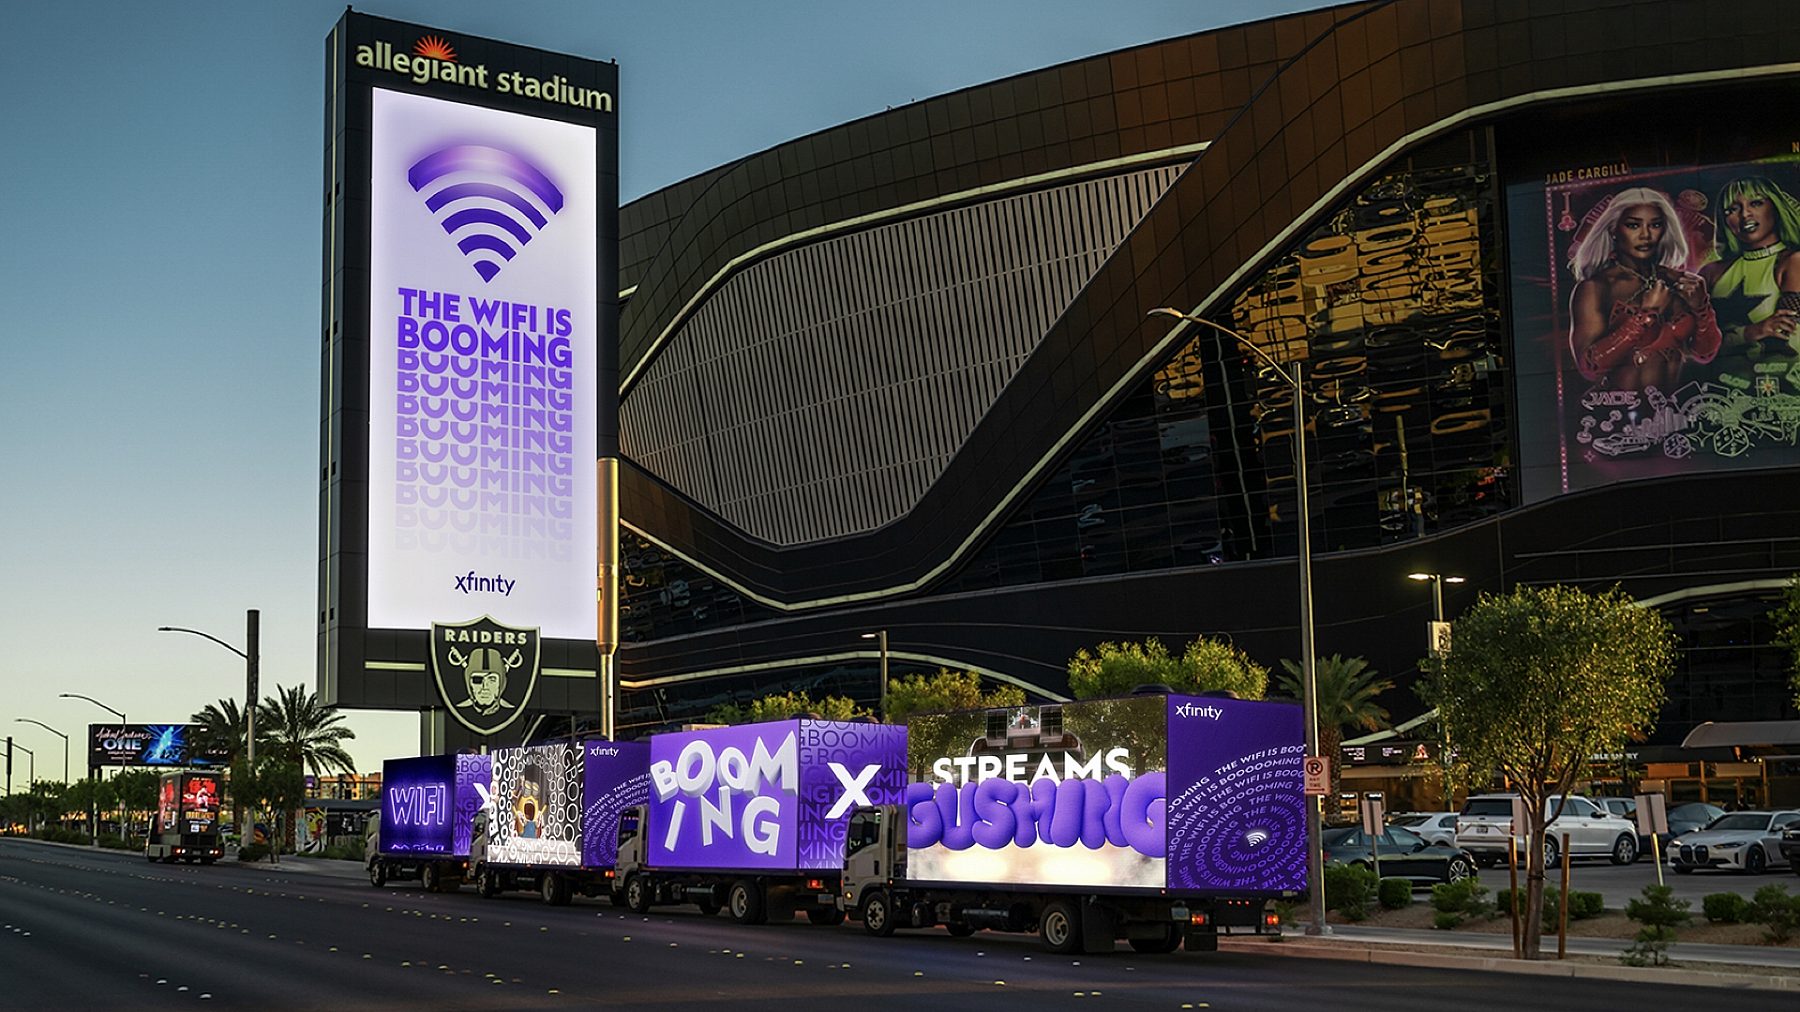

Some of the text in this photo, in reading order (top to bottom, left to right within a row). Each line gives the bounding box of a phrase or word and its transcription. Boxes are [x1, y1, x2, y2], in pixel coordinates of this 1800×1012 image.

[356, 40, 612, 112] allegiant stadium
[1545, 163, 1628, 185] JADE CARGILL
[398, 287, 572, 337] THE WIFI IS
[397, 316, 572, 368] BOOMING
[455, 571, 515, 596] xfinity
[445, 629, 527, 645] RAIDERS
[1176, 703, 1222, 720] xfinity
[103, 739, 142, 750] ONE
[590, 746, 619, 757] xfinity
[650, 731, 798, 804] BOOM
[933, 748, 1131, 787] STREAMS
[1215, 760, 1238, 775] THE
[1240, 750, 1265, 764] WIFI
[1267, 747, 1278, 757] IS
[1182, 791, 1207, 811] WIFI
[1207, 783, 1218, 793] IS
[1210, 786, 1233, 802] THE
[1234, 774, 1260, 788] WIFI
[1263, 771, 1273, 780] IS
[389, 783, 446, 826] WIFI
[907, 773, 1166, 858] GUSHING
[664, 785, 780, 857] ING
